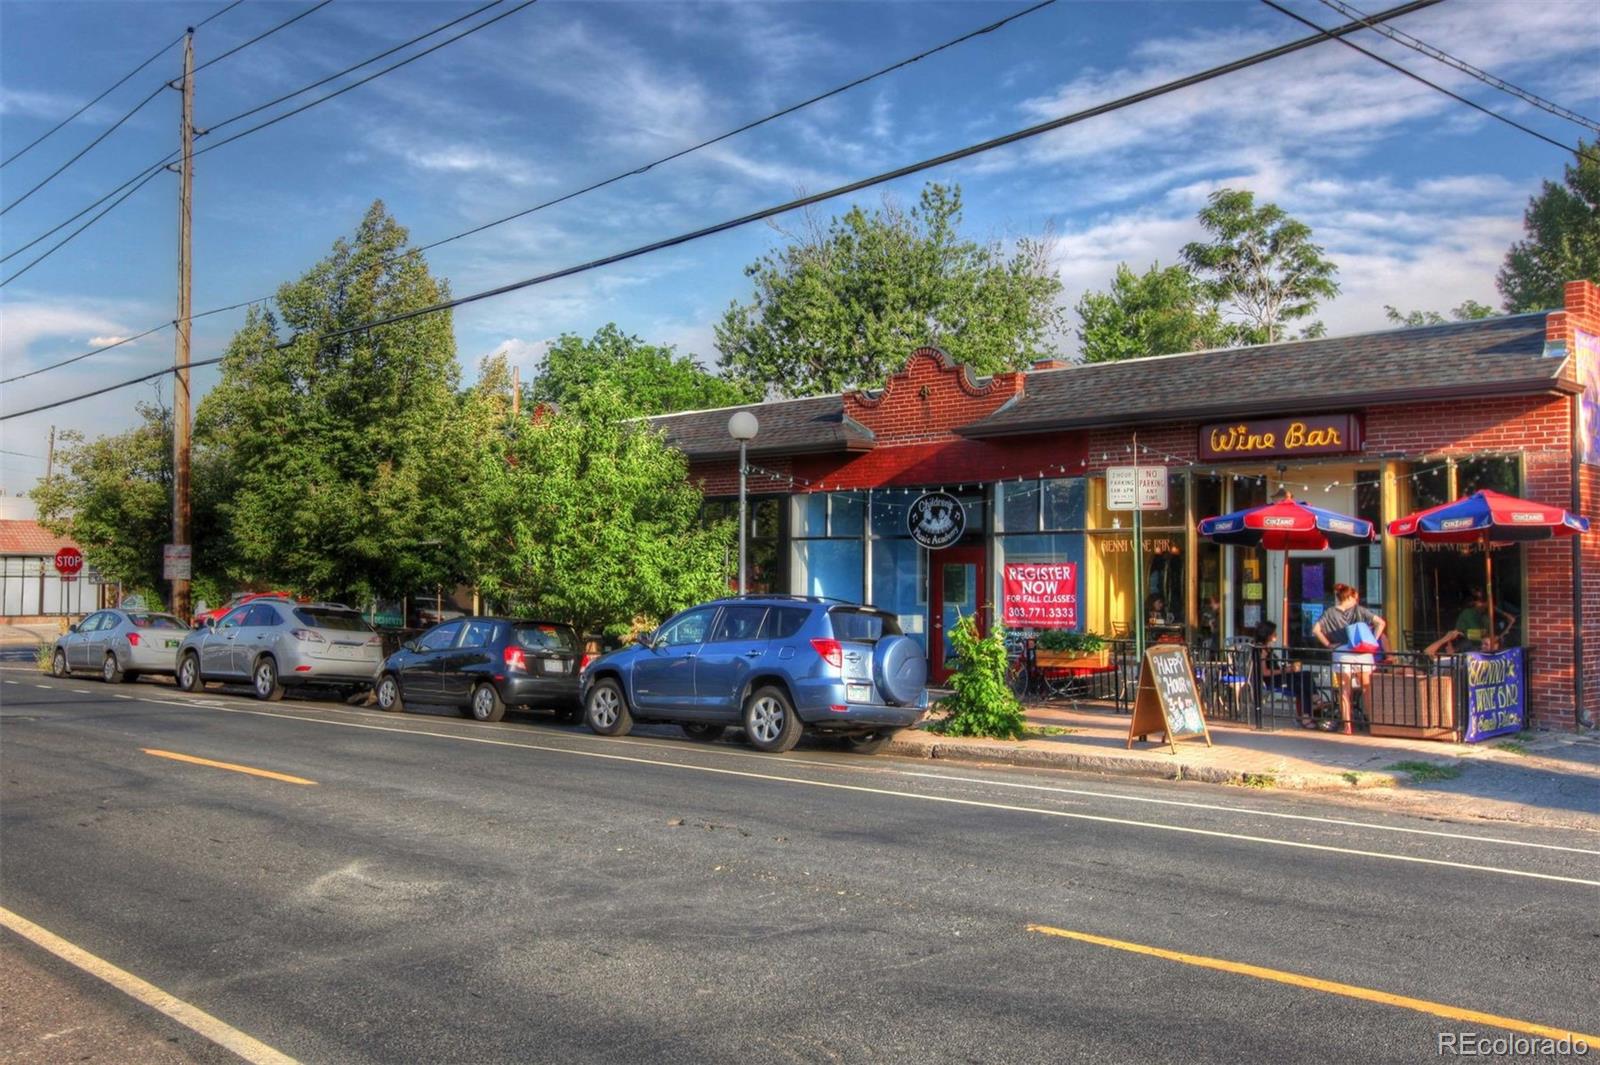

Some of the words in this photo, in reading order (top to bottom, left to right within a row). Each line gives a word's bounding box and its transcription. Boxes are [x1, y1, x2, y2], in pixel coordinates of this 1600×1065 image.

[1210, 424, 1275, 452] Wine
[1284, 422, 1342, 449] Bar
[1146, 470, 1158, 478] NO
[1140, 480, 1165, 488] PARKING
[1264, 518, 1295, 526] CINZANO
[913, 527, 931, 544] Music
[931, 526, 959, 545] Academy
[57, 555, 81, 568] STOP
[1009, 566, 1071, 580] REGISTER
[1022, 581, 1059, 595] NOW
[1006, 594, 1021, 603] FOR
[1023, 594, 1042, 603] FALL
[1043, 594, 1076, 603] CLASSES
[1008, 607, 1074, 618] 303.771.3333
[1153, 655, 1185, 675] HAPPY
[1163, 677, 1188, 695] HOUR
[1475, 686, 1497, 712] WINE
[1497, 684, 1519, 709] BAR
